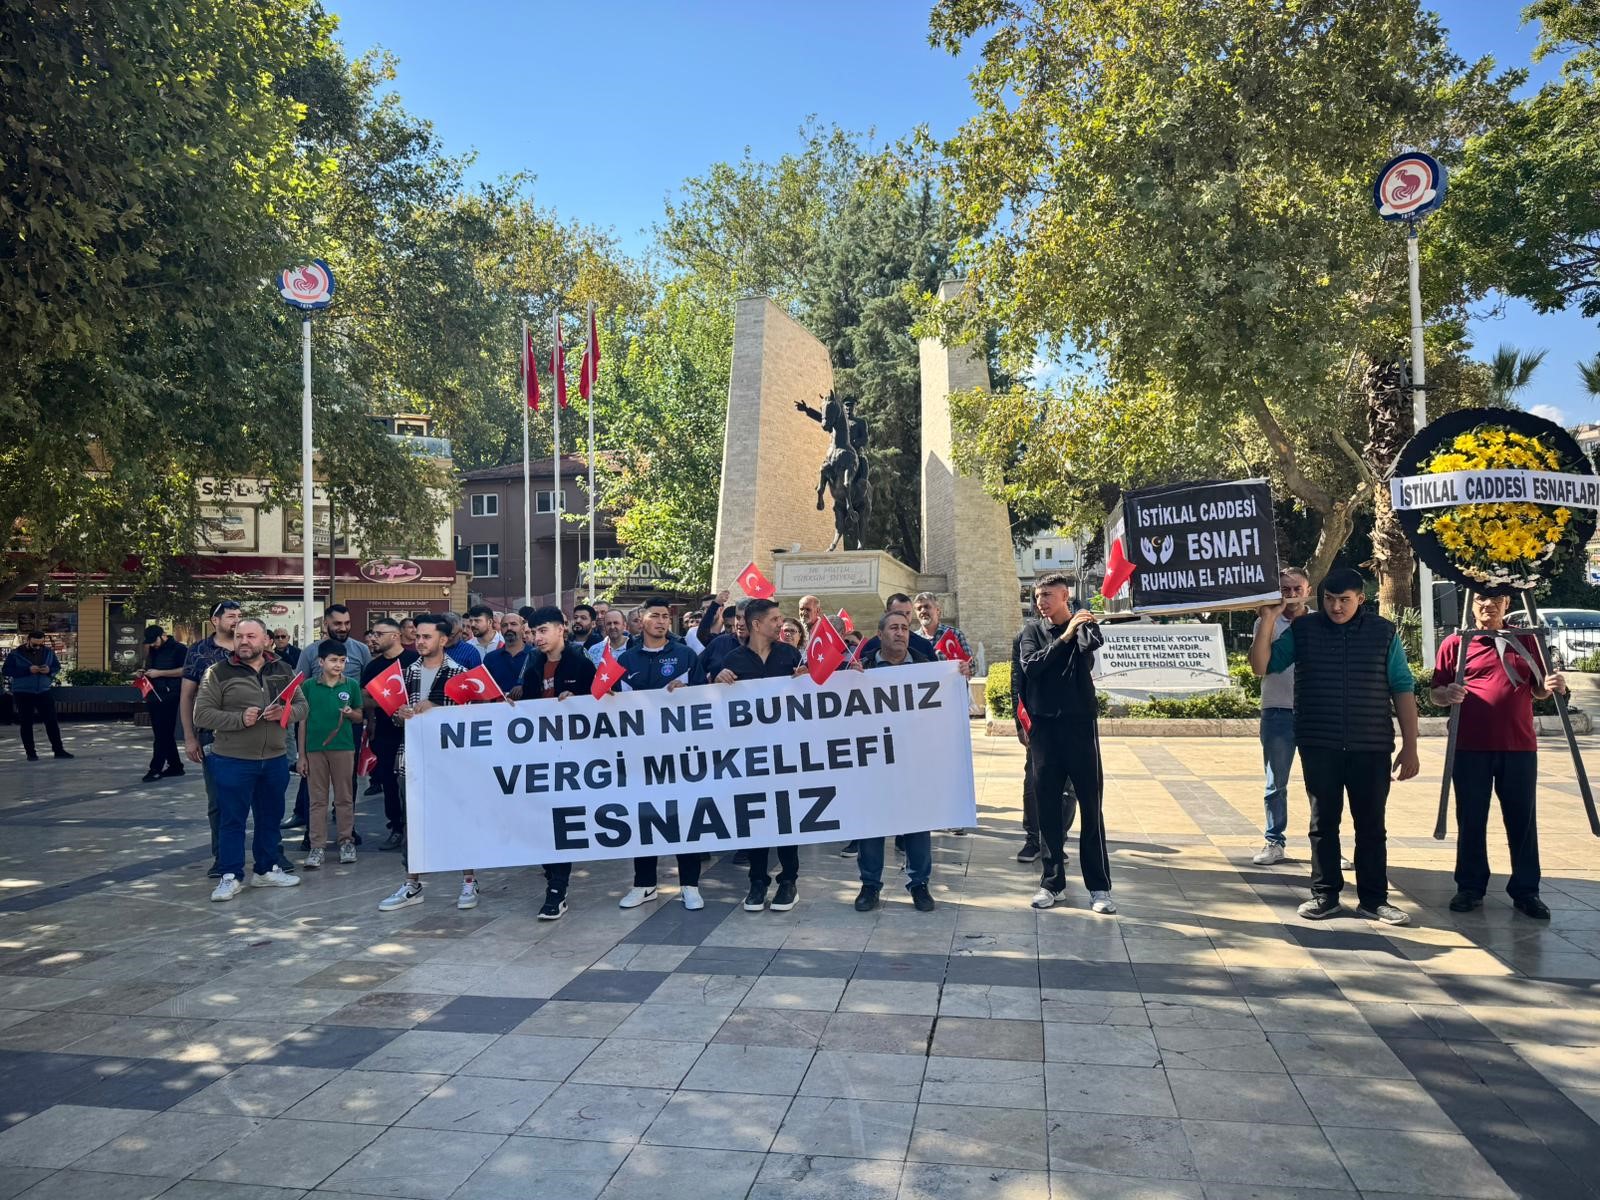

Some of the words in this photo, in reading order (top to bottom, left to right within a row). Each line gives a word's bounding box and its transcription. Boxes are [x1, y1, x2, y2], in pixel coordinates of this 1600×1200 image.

[1399, 477, 1458, 507] İSTİKLAL
[1465, 471, 1527, 500] CADDESİ
[1533, 477, 1600, 506] ESNAFLARI
[1137, 504, 1197, 528] İSTİKLAL
[1200, 495, 1257, 522] CADDESİ
[1187, 528, 1260, 561] ESNAFI
[1140, 569, 1197, 592] RUHUNA
[1199, 568, 1215, 586] EL
[1218, 562, 1265, 584] FATİHA
[1104, 635, 1130, 643] İLLETE
[1132, 635, 1173, 643] EFENDİLİK
[1109, 643, 1141, 651] HİZMET
[1153, 651, 1185, 659] HİZMET
[1139, 659, 1176, 667] EFENDİSİ
[441, 721, 493, 750] NE
[507, 709, 645, 744] ONDAN
[660, 704, 714, 734] NE
[726, 681, 942, 728] BUNDANIZ
[492, 751, 627, 794] VERGİ
[644, 726, 895, 786] MÜKELLEFİ
[552, 785, 841, 852] ESNAFIZ
